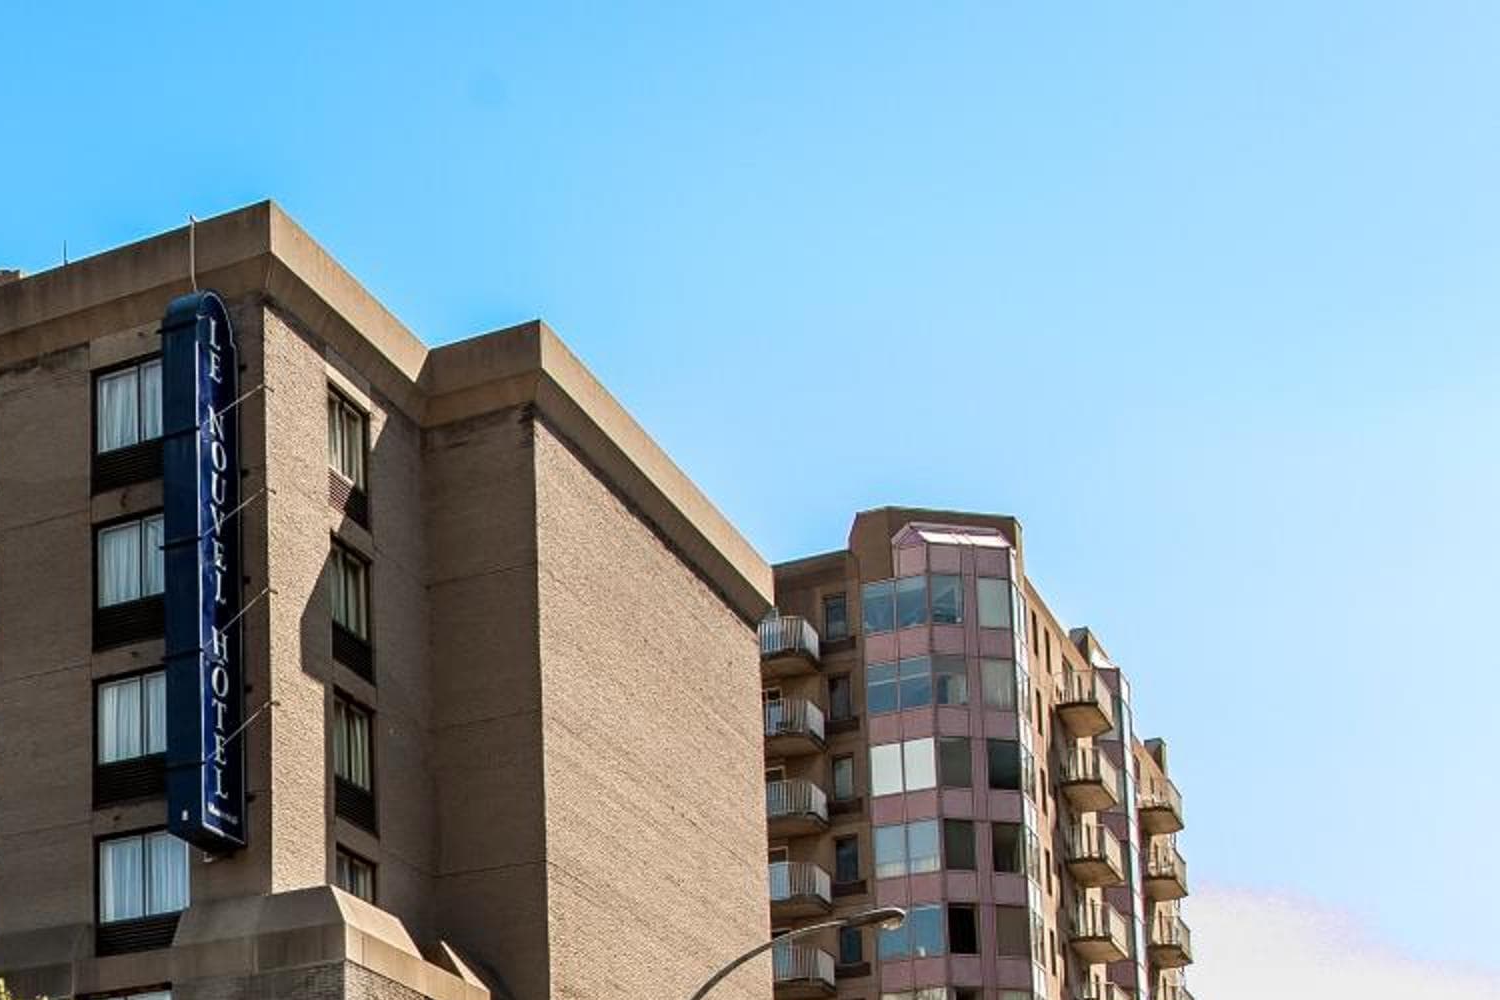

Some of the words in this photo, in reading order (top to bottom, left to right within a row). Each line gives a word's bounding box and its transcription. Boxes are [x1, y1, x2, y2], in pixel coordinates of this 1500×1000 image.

[208, 316, 222, 384] LE
[207, 404, 228, 604] NOUVEL
[210, 624, 230, 800] HOTEL
